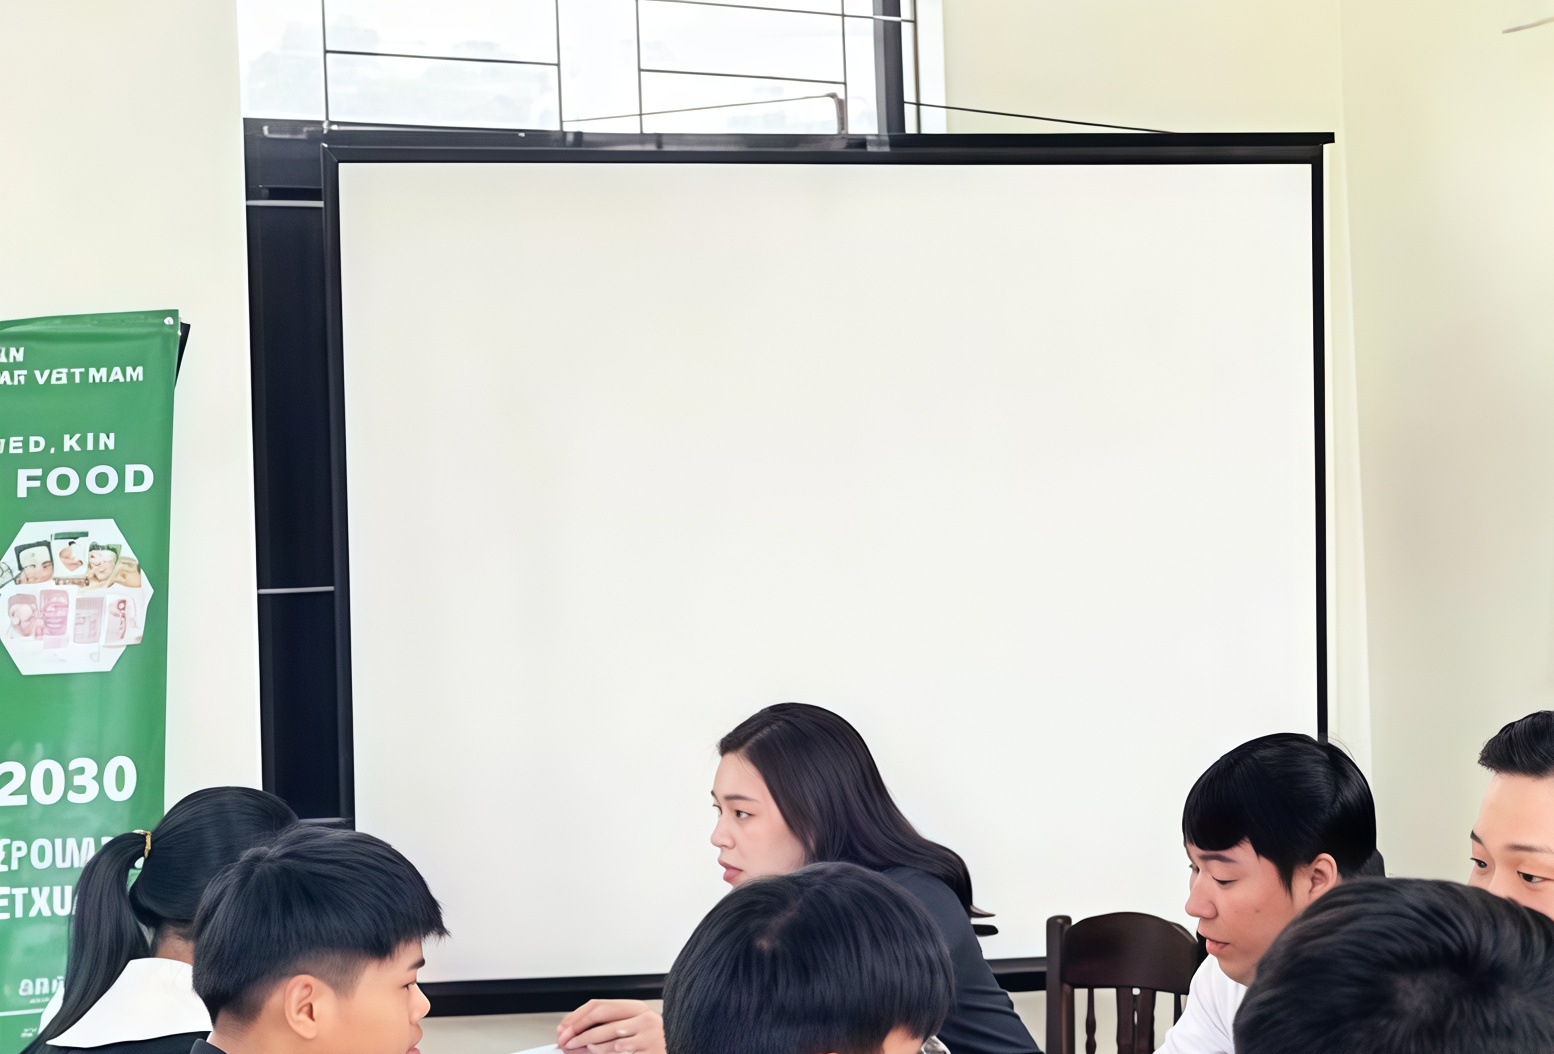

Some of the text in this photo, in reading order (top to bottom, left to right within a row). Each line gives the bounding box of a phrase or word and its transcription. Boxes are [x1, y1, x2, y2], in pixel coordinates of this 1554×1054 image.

[63, 432, 116, 452] KIN
[16, 463, 155, 498] FOOD
[0, 755, 138, 807] 2030
